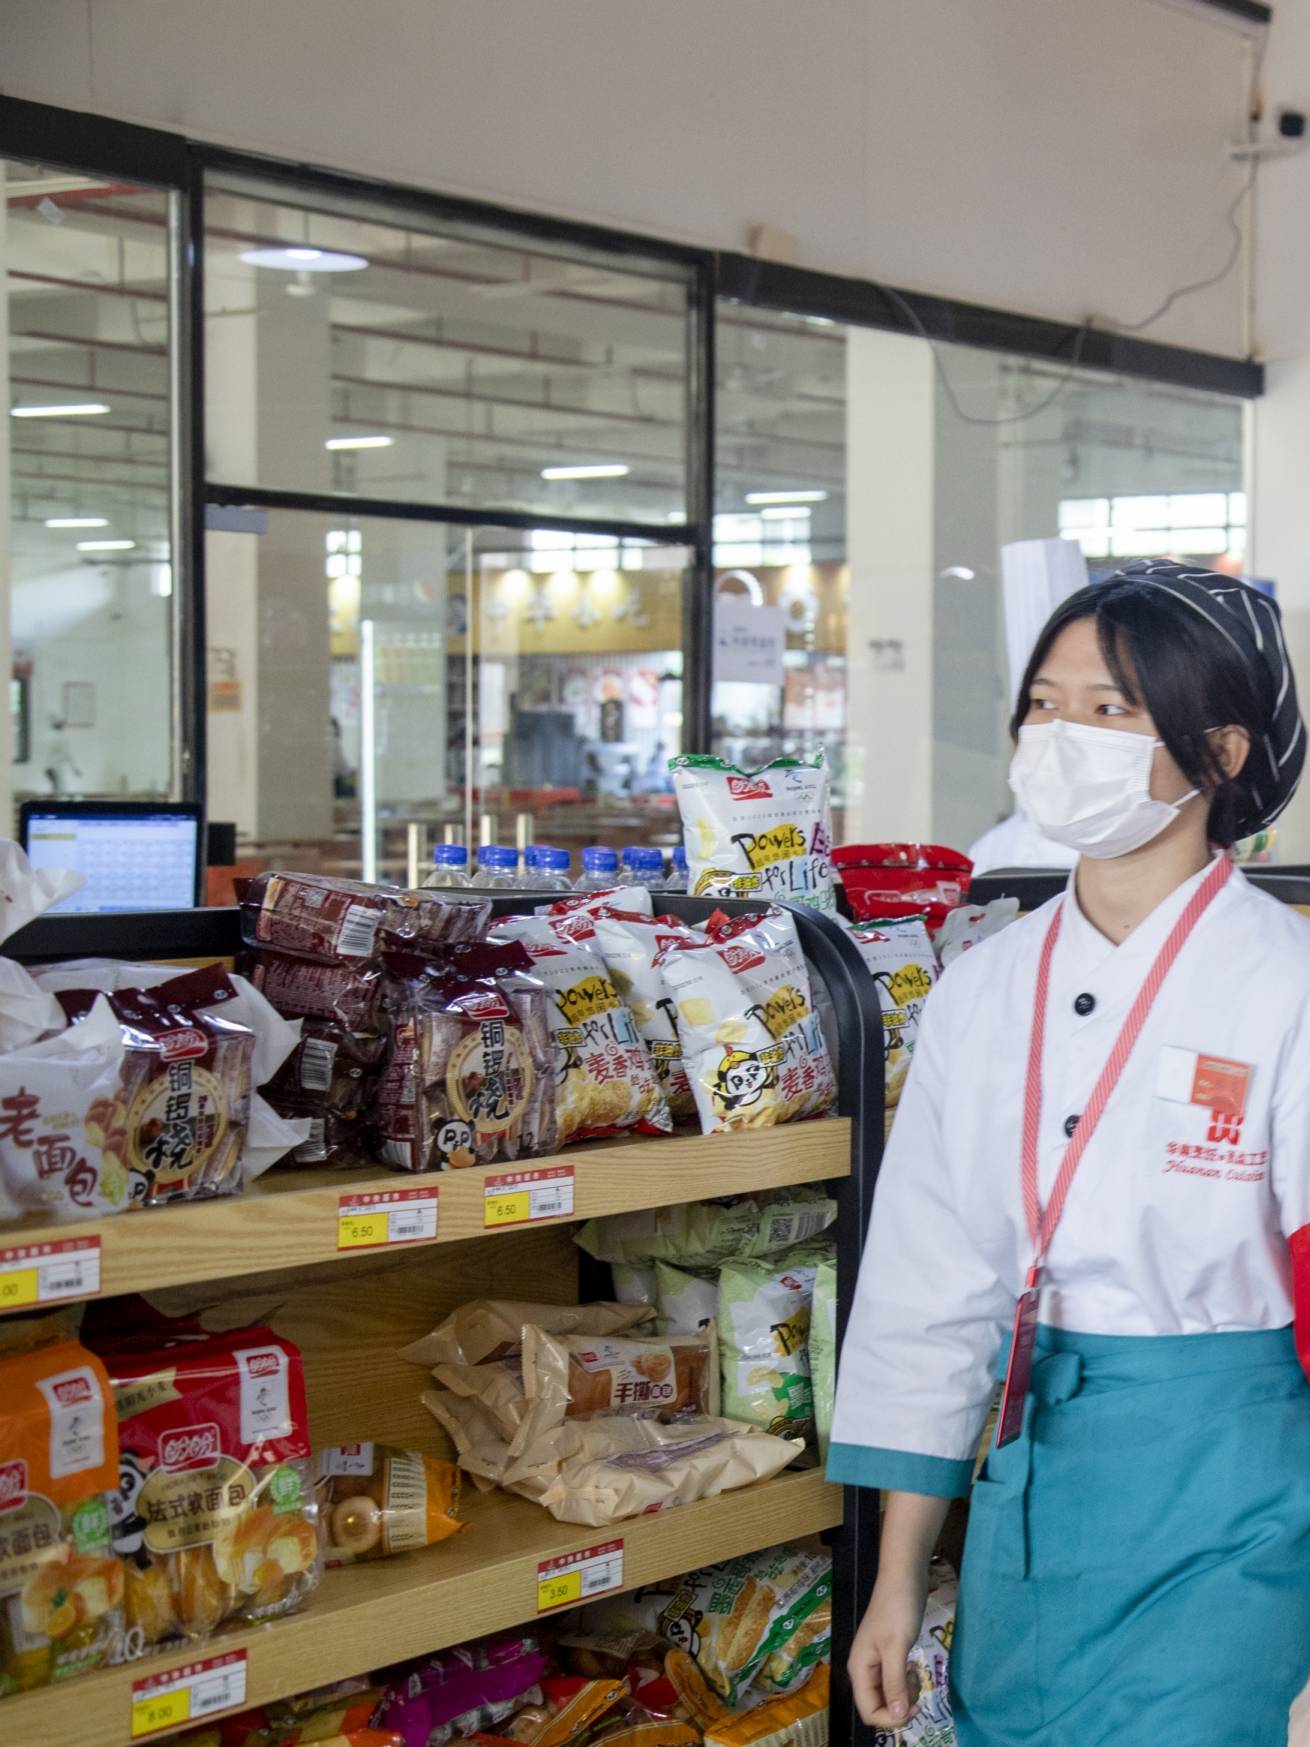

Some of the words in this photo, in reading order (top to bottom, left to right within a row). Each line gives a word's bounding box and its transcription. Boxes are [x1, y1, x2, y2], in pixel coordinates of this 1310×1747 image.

[731, 826, 806, 869] Powers
[762, 864, 786, 891] for
[789, 858, 829, 892] Life
[470, 1021, 511, 1120] 铜锣烧
[146, 1059, 194, 1169] 铜锣烧
[0, 1085, 99, 1208] 老面包
[496, 1203, 517, 1217] 6.50
[351, 1225, 374, 1239] 6.50
[146, 1484, 246, 1522] 法式软面包
[549, 1584, 569, 1600] 3.50
